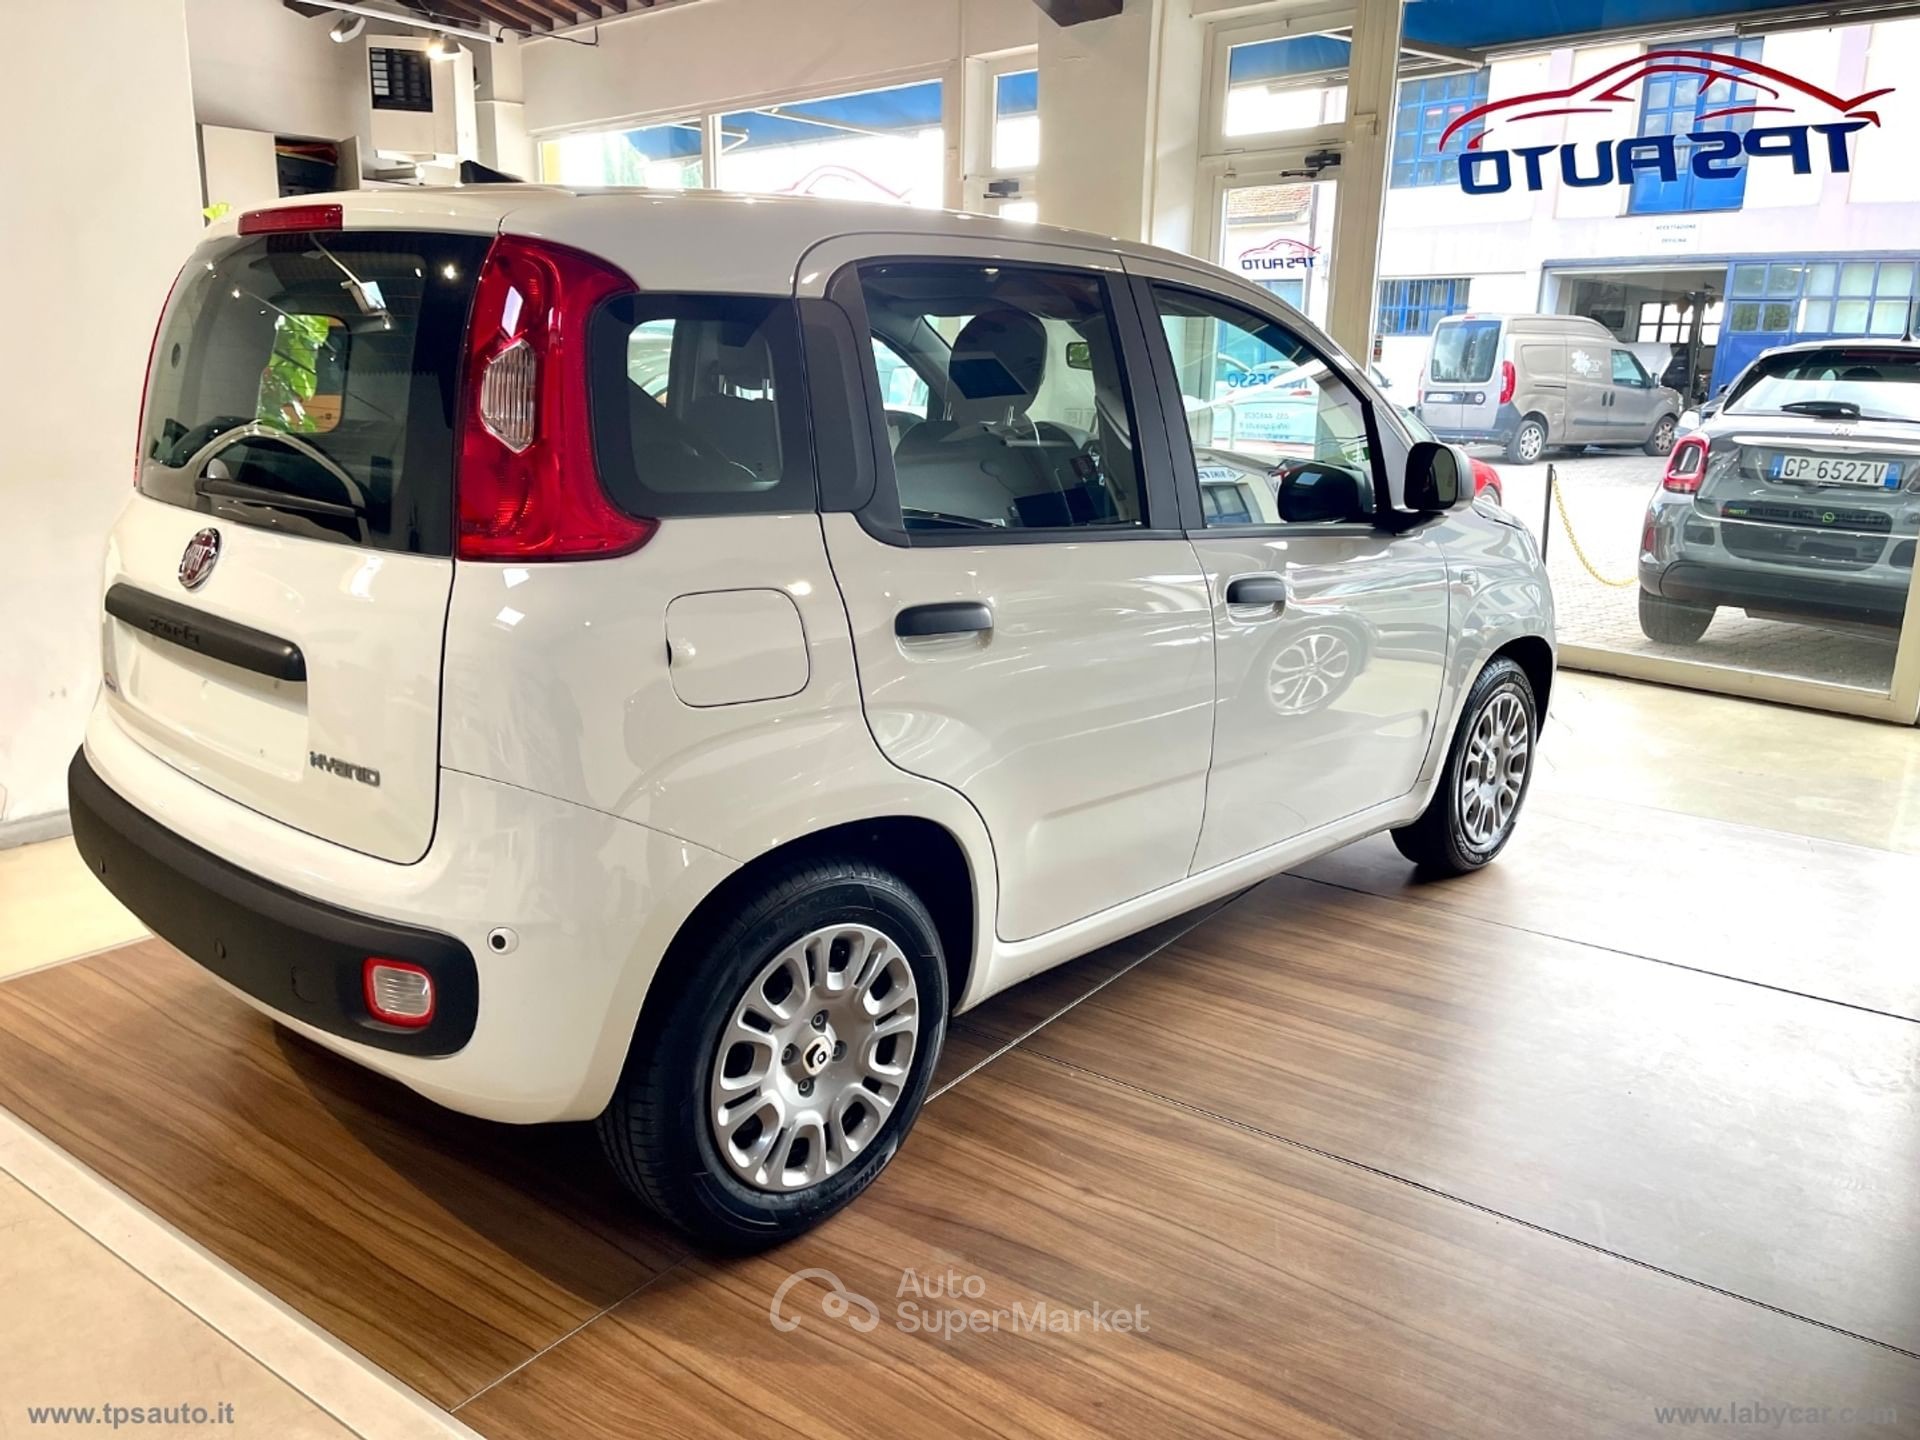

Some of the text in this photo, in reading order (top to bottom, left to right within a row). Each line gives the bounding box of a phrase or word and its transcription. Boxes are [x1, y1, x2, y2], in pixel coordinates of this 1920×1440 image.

[1784, 458, 1810, 478] GP
[1816, 460, 1885, 484] 652ZV
[309, 750, 381, 788] HYBRID
